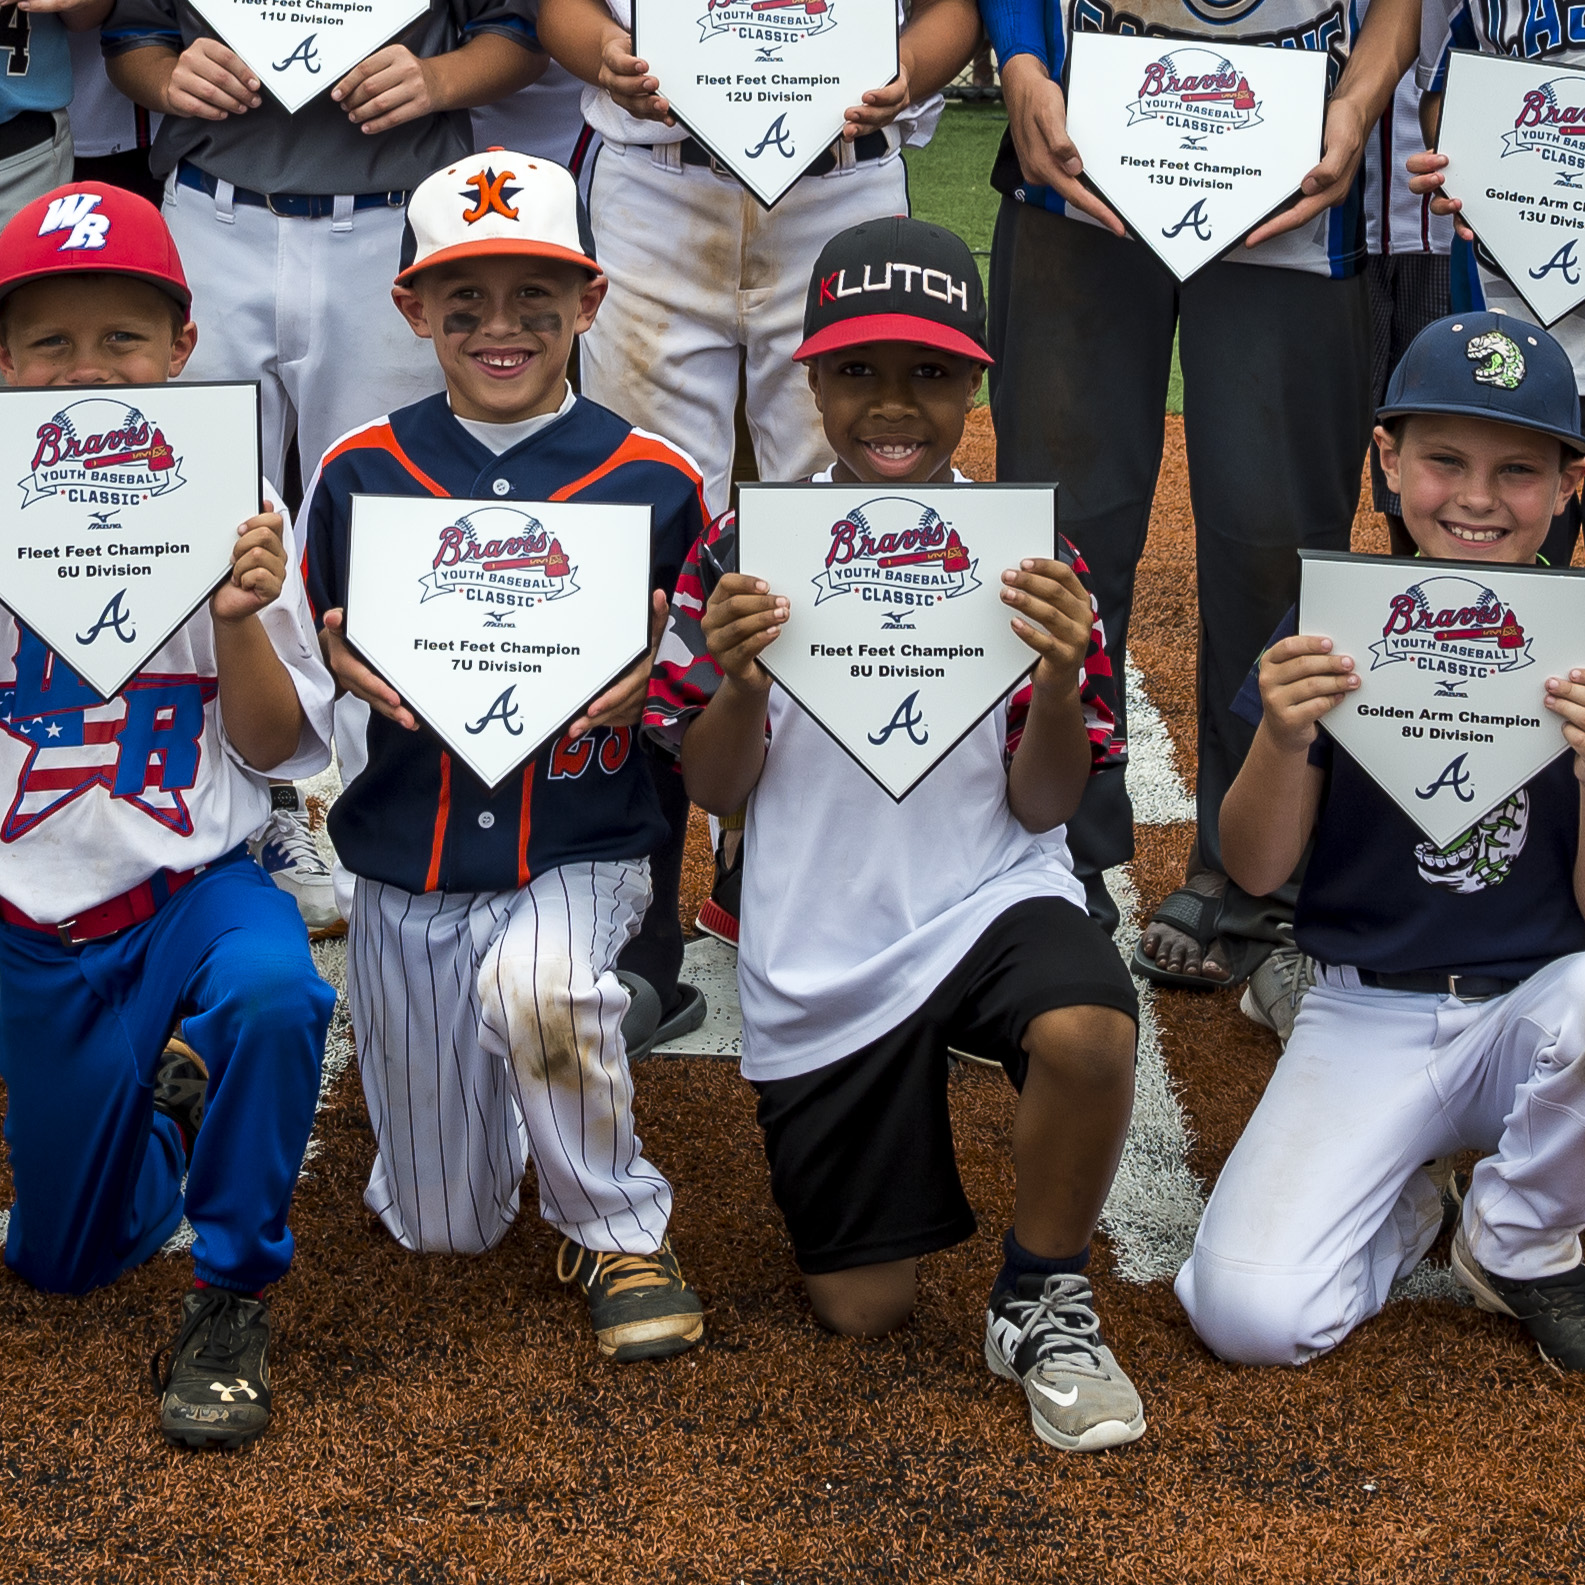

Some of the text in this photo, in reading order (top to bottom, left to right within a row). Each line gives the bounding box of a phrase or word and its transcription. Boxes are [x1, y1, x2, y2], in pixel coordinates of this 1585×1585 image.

[306, 0, 372, 13] Champion
[260, 12, 344, 26] 11U Division
[738, 27, 798, 42] CLASSIC
[696, 74, 840, 86] Fleet Feet Champion
[1138, 62, 1237, 98] Braves
[726, 92, 812, 102] 12U Division
[1120, 156, 1262, 177] Fleet Feet Champion
[1148, 174, 1233, 190] 13U Division
[1486, 188, 1535, 206] Golden
[1538, 196, 1568, 209] Arm
[1518, 210, 1546, 224] 13U
[819, 261, 967, 312] KLUTCH
[31, 421, 149, 472] Braves
[68, 489, 139, 506] CLASSIC
[18, 542, 190, 560] Fleet Feet Champion
[433, 526, 548, 570] Braves
[825, 520, 945, 568] Braves
[57, 564, 152, 578] 6U Division
[466, 588, 535, 608] CLASSIC
[862, 588, 935, 607] CLASSIC
[1383, 594, 1502, 637] Braves
[414, 639, 580, 657] Fleet Feet Champion
[810, 644, 984, 660] Fleet Feet Champion
[451, 658, 542, 673] 7U Division
[850, 665, 945, 678] 8U Division
[1417, 657, 1488, 679] CLASSIC
[1357, 704, 1540, 729] Golden Arm Champion
[1402, 726, 1494, 743] 8U Division
